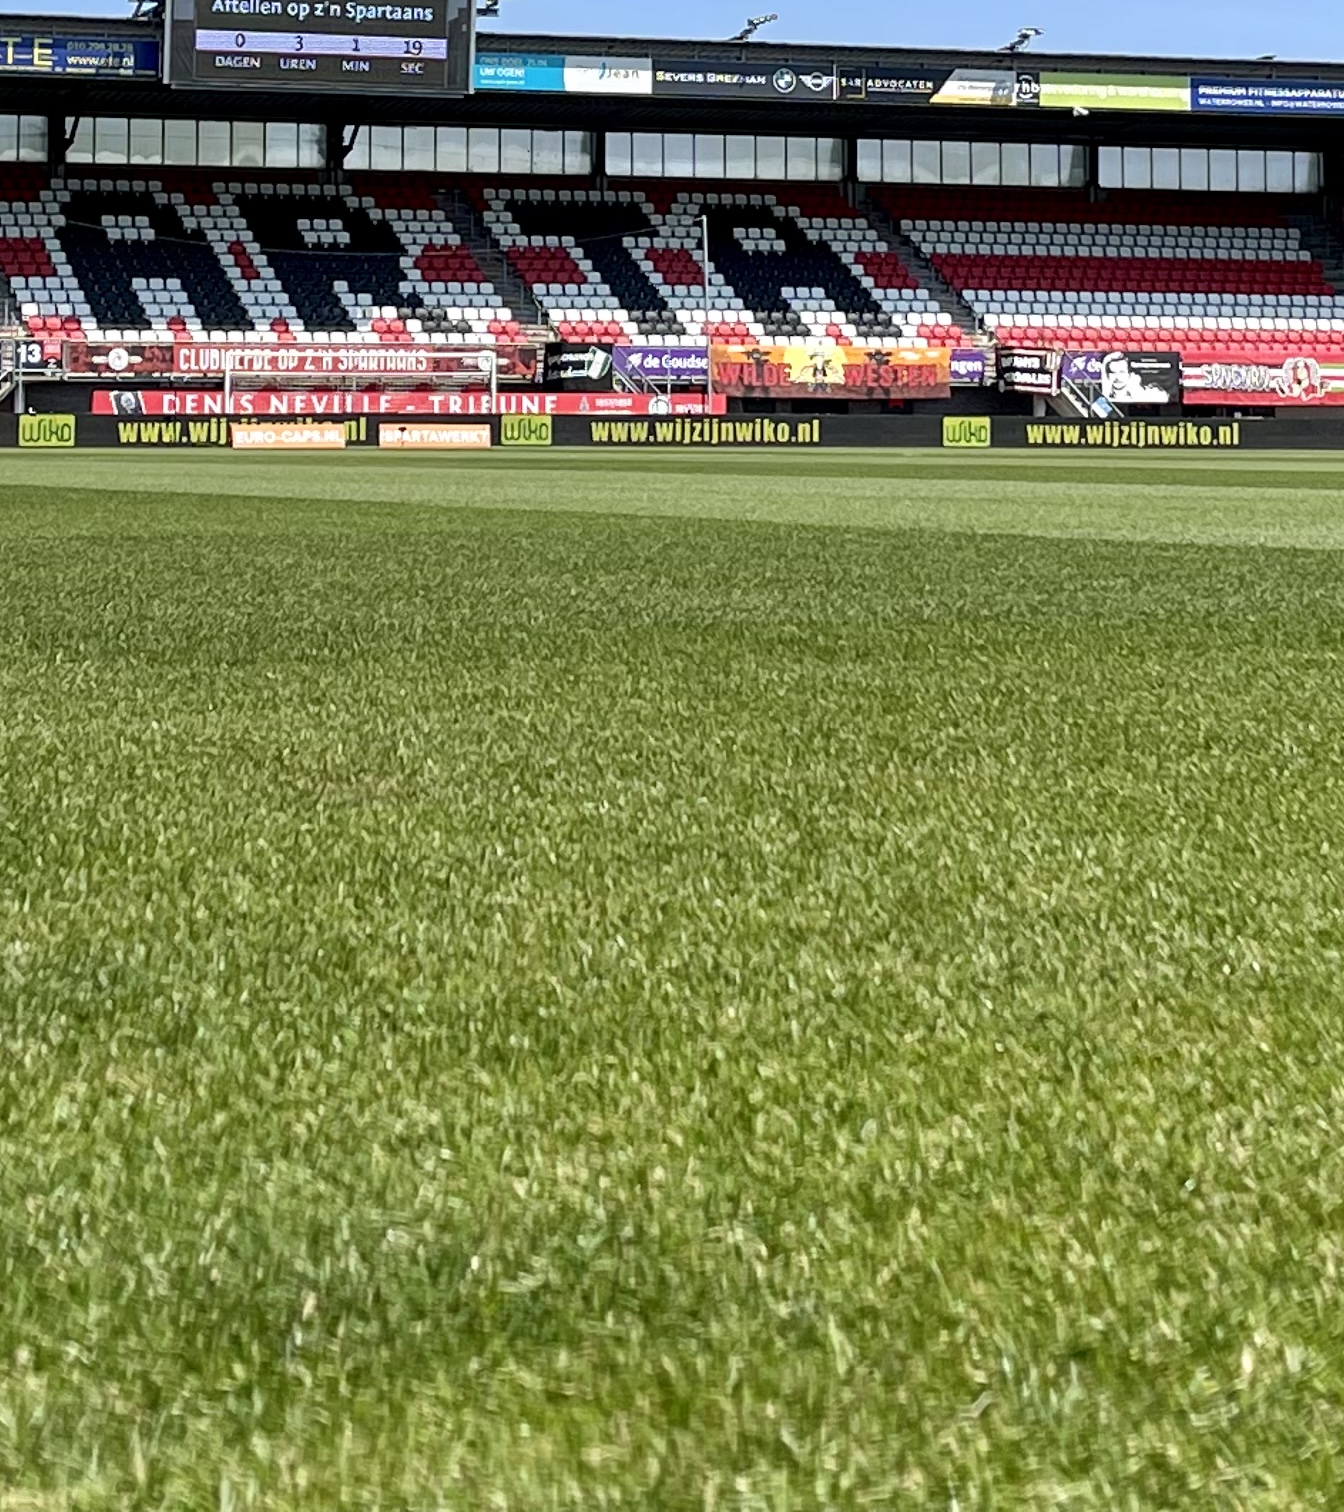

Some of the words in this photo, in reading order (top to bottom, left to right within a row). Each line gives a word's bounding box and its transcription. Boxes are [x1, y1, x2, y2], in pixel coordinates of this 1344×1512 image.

[287, 2, 310, 20] op
[313, 1, 341, 17] z'n
[346, 2, 434, 21] Spartaans
[235, 33, 245, 48] 0
[295, 35, 304, 51] 3
[352, 37, 360, 52] 1
[404, 40, 423, 55] 19
[215, 55, 261, 68] DAGEN
[279, 57, 316, 70] UREN
[342, 60, 370, 72] MIN
[400, 62, 424, 74] SEC
[867, 79, 934, 89] ADVOCATEN
[16, 344, 42, 363] 13
[643, 353, 660, 368] de
[662, 354, 708, 369] Goudse
[718, 362, 791, 387] WILDE
[845, 364, 938, 387] WESTEN
[236, 427, 344, 444] EURO-CAPS.NL
[591, 418, 820, 444] www.wijzijnwiko.nl
[1026, 422, 1240, 447] www.wijzijnwiko.nl
